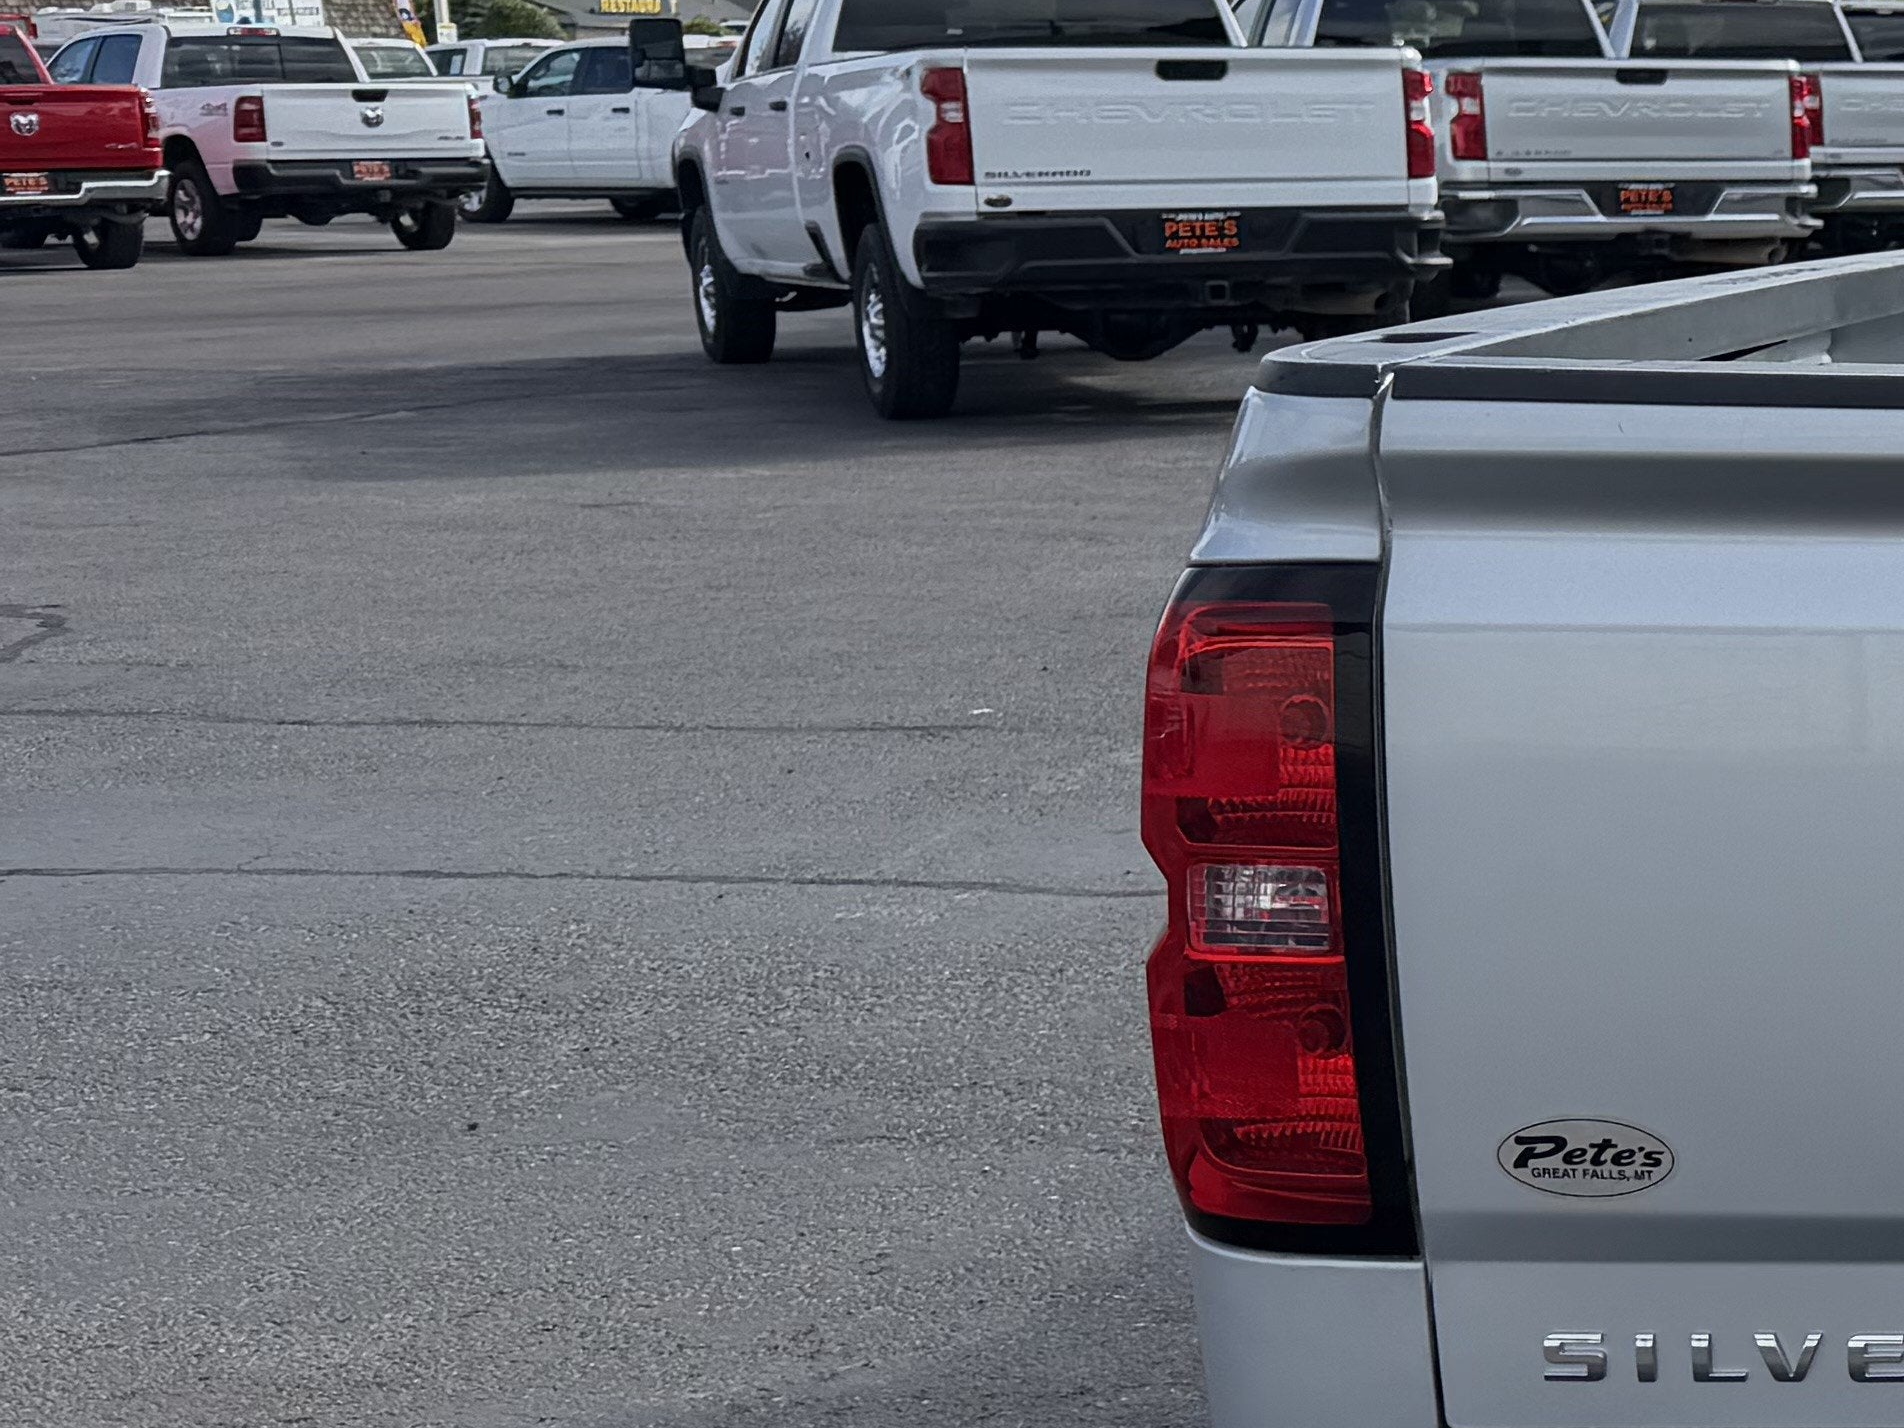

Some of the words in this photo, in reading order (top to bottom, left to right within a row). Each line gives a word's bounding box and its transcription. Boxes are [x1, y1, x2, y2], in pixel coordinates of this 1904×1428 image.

[1002, 103, 1376, 125] CHEVROLET
[1506, 100, 1770, 118] CHEVROLET
[1164, 219, 1238, 237] PETE'S
[1513, 1135, 1665, 1169] Pete's
[1531, 1167, 1579, 1179] GREAT
[1582, 1168, 1631, 1182] FALLS,
[1633, 1169, 1654, 1181] MT
